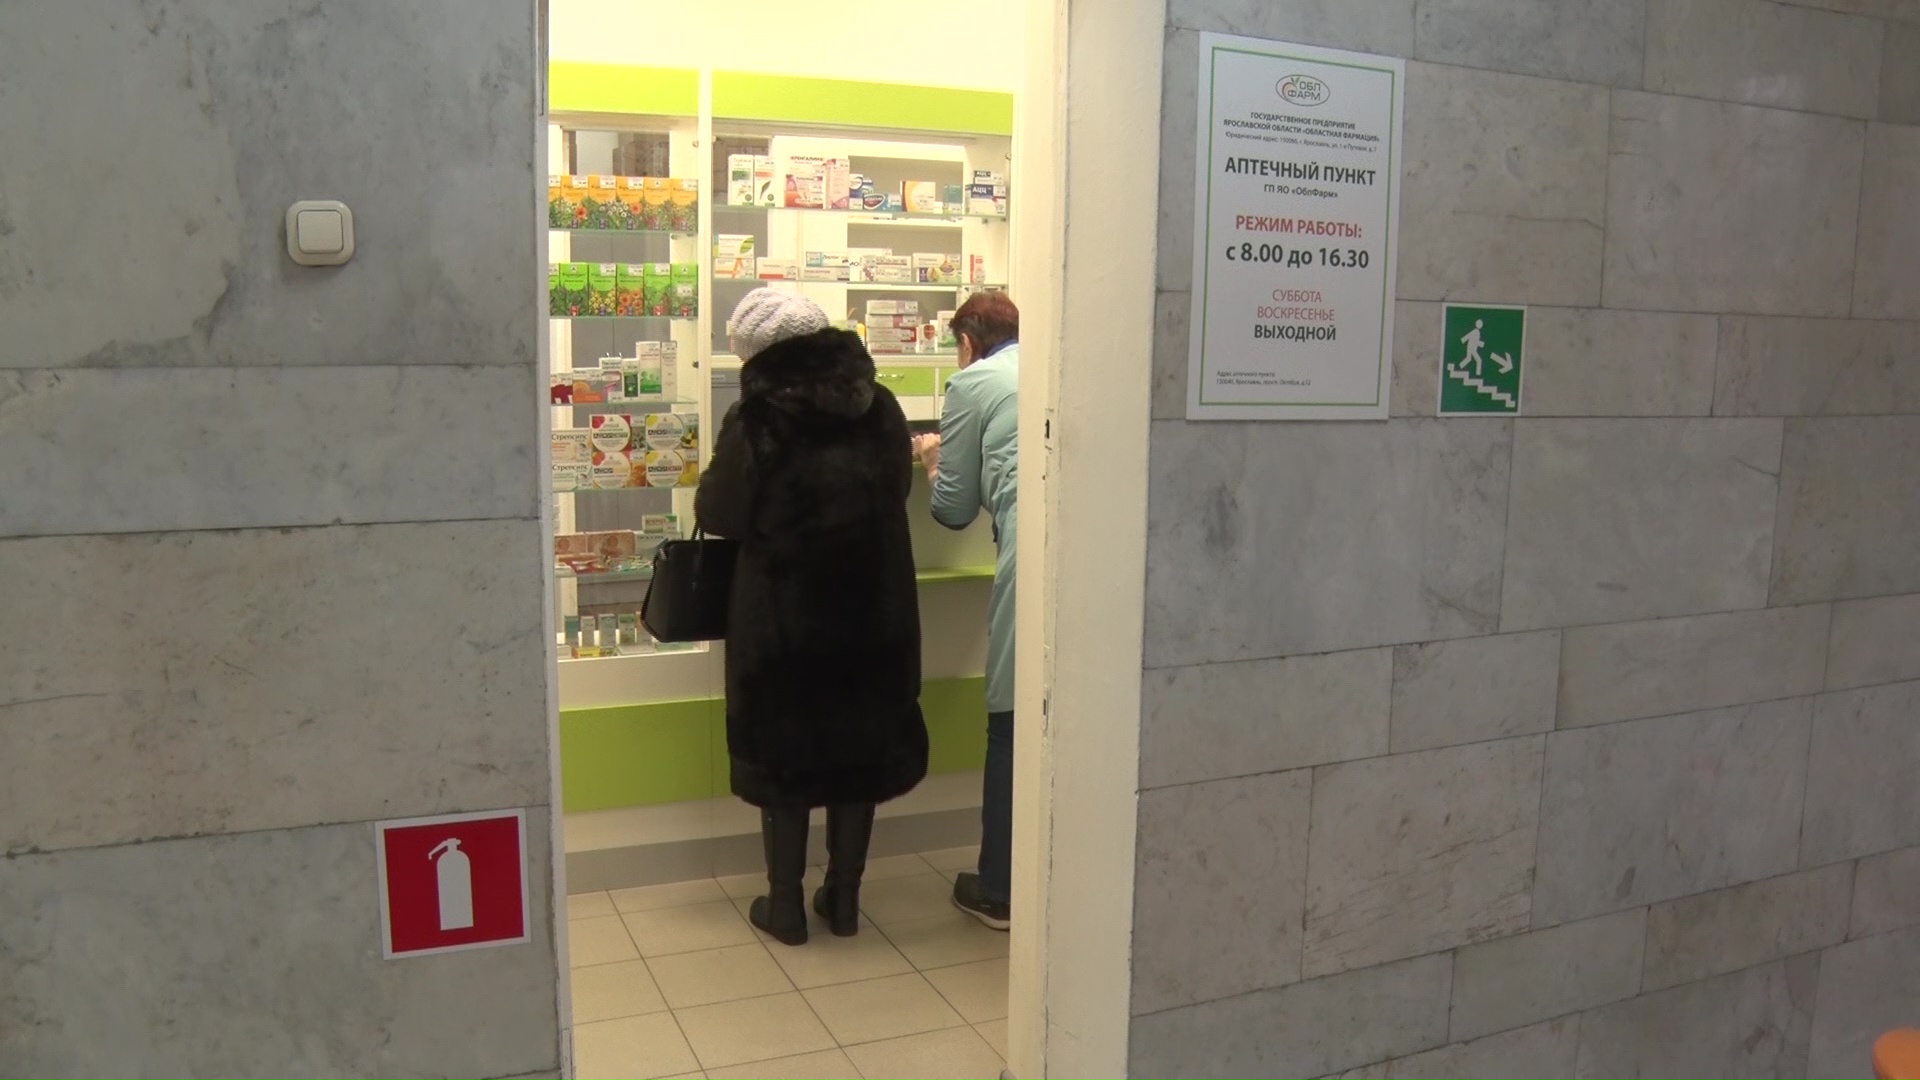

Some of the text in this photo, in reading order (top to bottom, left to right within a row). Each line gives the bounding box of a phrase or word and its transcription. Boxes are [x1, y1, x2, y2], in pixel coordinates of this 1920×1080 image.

[1299, 80, 1321, 92] ОБЛ
[1287, 89, 1321, 101] ФАРМ
[1223, 119, 1271, 131] ЯРОСЛАВСКОЙ
[1272, 123, 1302, 134] ОБЛАСТИ
[1250, 112, 1356, 130] ГОСУДАРСТВЕННОЕ ПРЕДПРИЯТИЕ
[1225, 131, 1262, 141] Юридический
[1225, 156, 1376, 186] АПТЕЧНЫЙ ПУНКТ
[972, 186, 987, 194] АЦЦ
[1264, 184, 1339, 199] ГП ЯО «ОблФарм»
[1235, 215, 1362, 238] РЕЖИМ РАБОТЫ:
[1226, 242, 1369, 269] с 8.00 до 16.30
[1272, 289, 1322, 303] СУББОТА
[1257, 306, 1335, 321] ВОСКРЕСЕНЬЕ
[1254, 324, 1337, 342] ВЫХОДНОЙ
